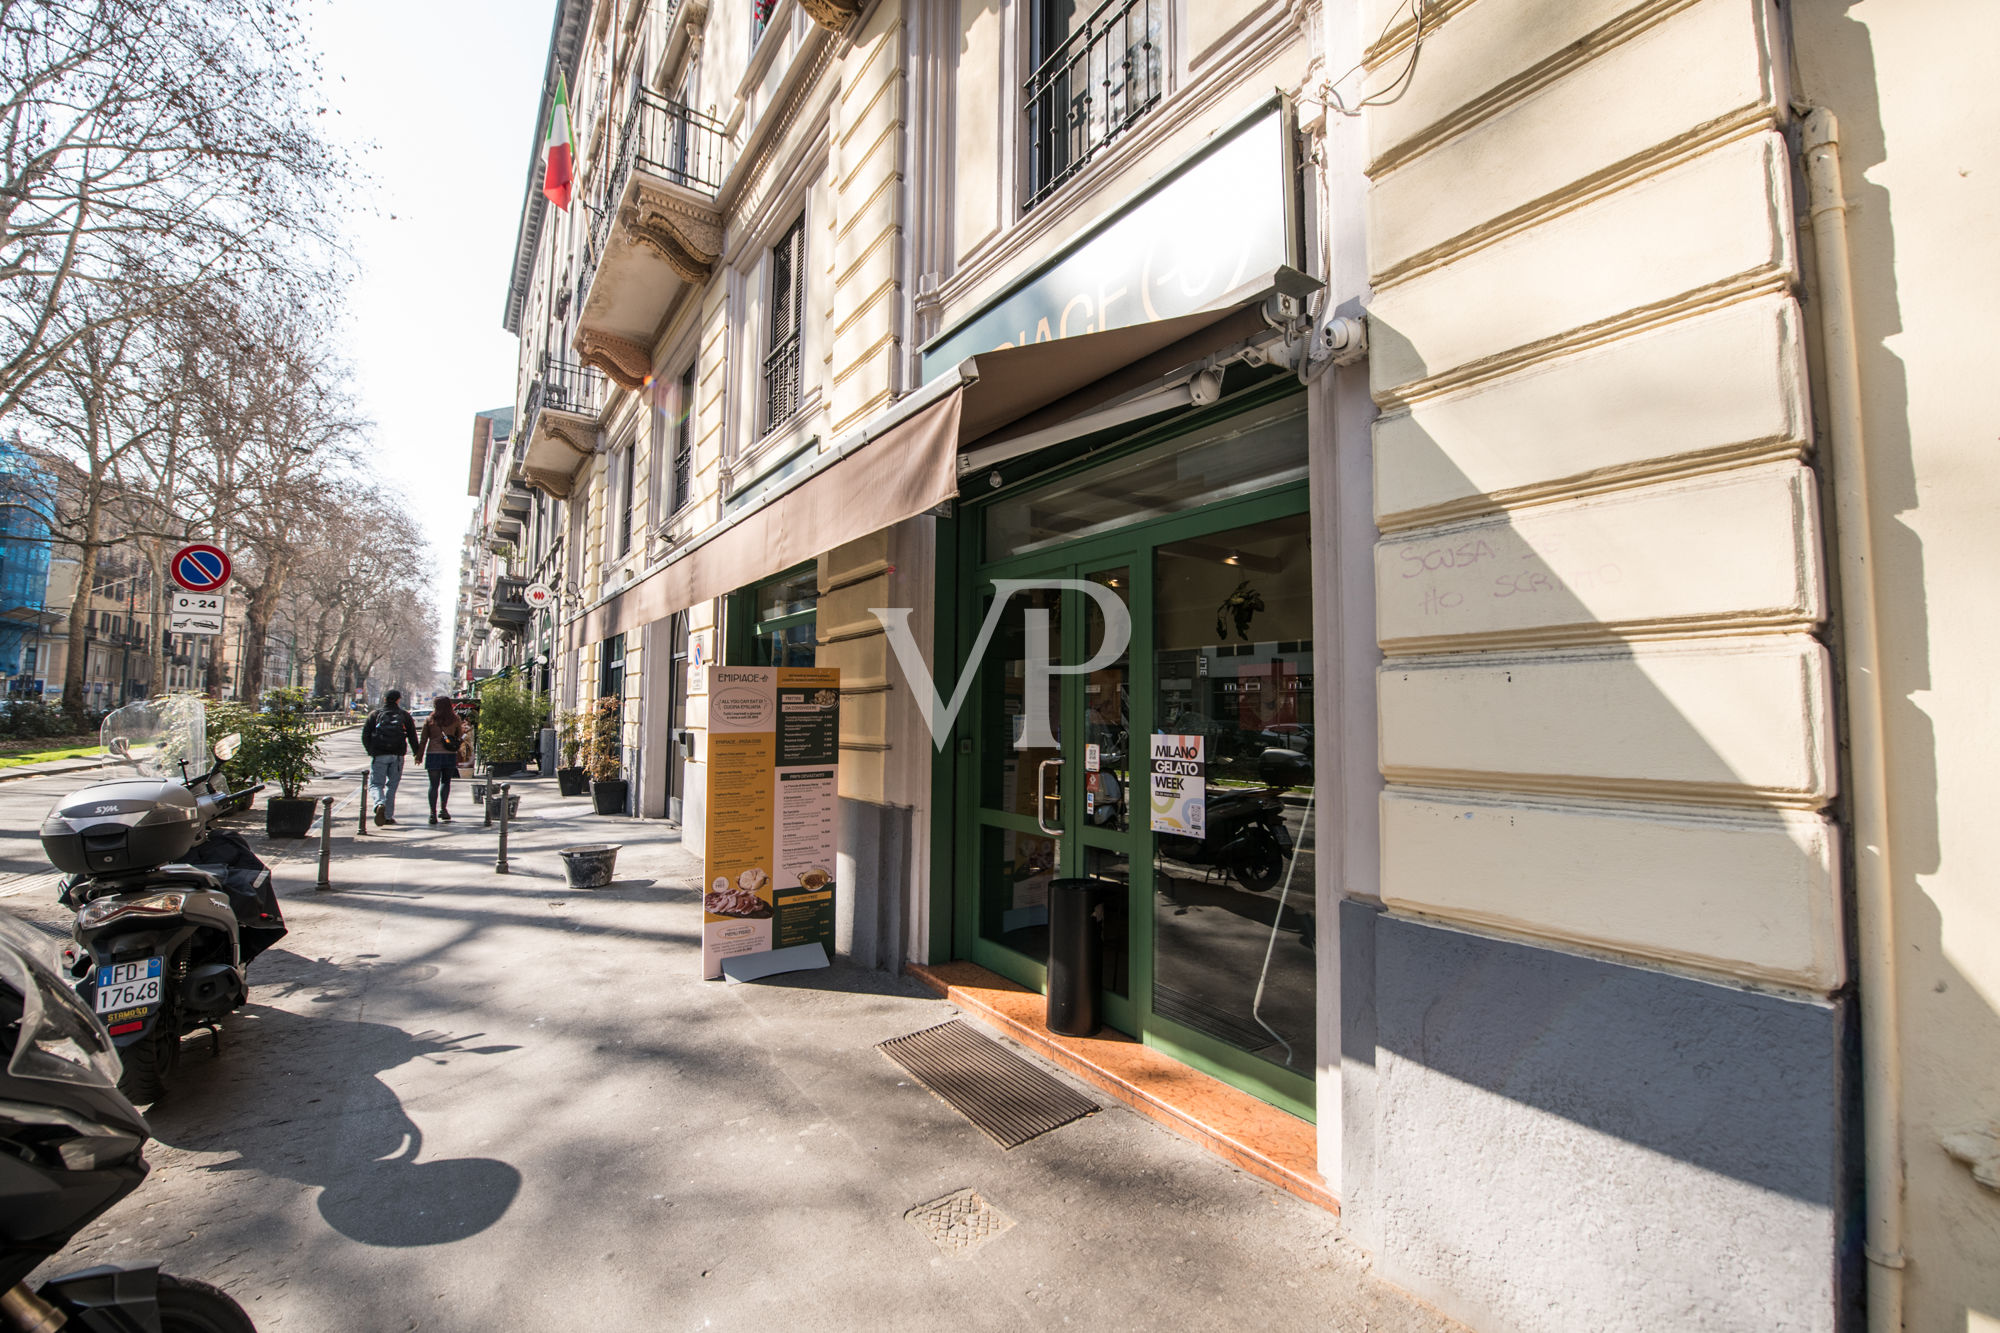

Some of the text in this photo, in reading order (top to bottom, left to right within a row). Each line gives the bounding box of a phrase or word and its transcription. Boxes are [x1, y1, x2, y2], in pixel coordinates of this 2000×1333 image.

[1400, 540, 1496, 578] SCUSA
[1418, 588, 1464, 615] HO
[718, 673, 760, 683] EMIPIACE
[1155, 744, 1198, 759] MILANO
[1155, 760, 1199, 776] GELATO
[1155, 775, 1184, 791] WEEK
[95, 804, 120, 814] SYM
[113, 963, 138, 985] FD
[100, 981, 158, 1009] 17648
